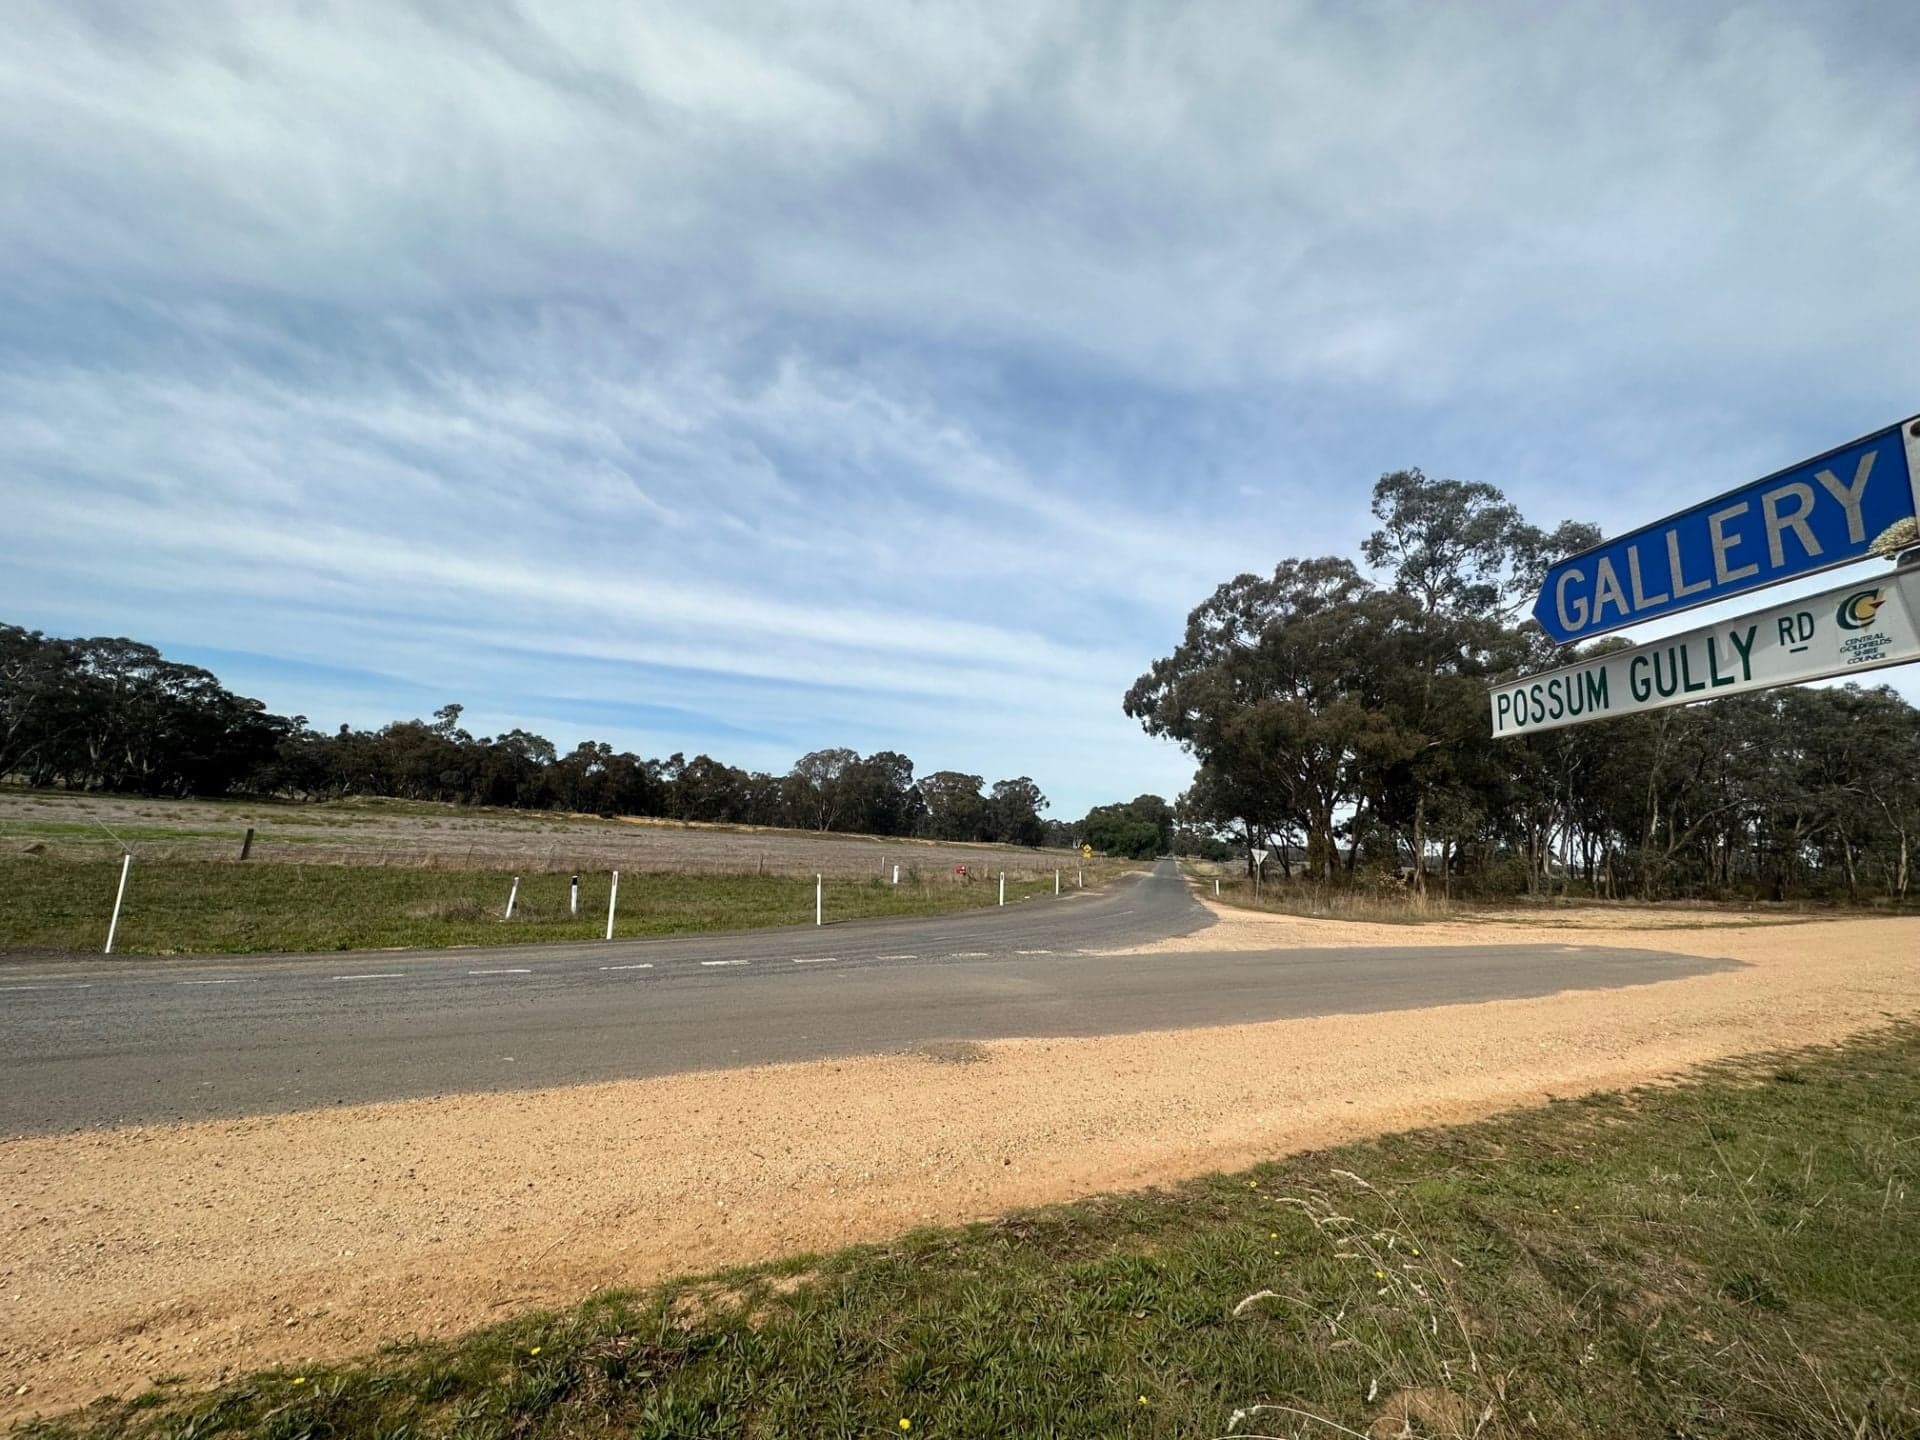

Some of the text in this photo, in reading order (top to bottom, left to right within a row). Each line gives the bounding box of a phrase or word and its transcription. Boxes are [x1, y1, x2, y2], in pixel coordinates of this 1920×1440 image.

[1556, 450, 1878, 632] GALLERY
[1840, 637, 1892, 654] GOLDFIELDS
[1845, 632, 1885, 646] CENTRAL
[1847, 652, 1886, 665] COUNCIL
[1497, 611, 1815, 731] POSSUM GULLY RD
